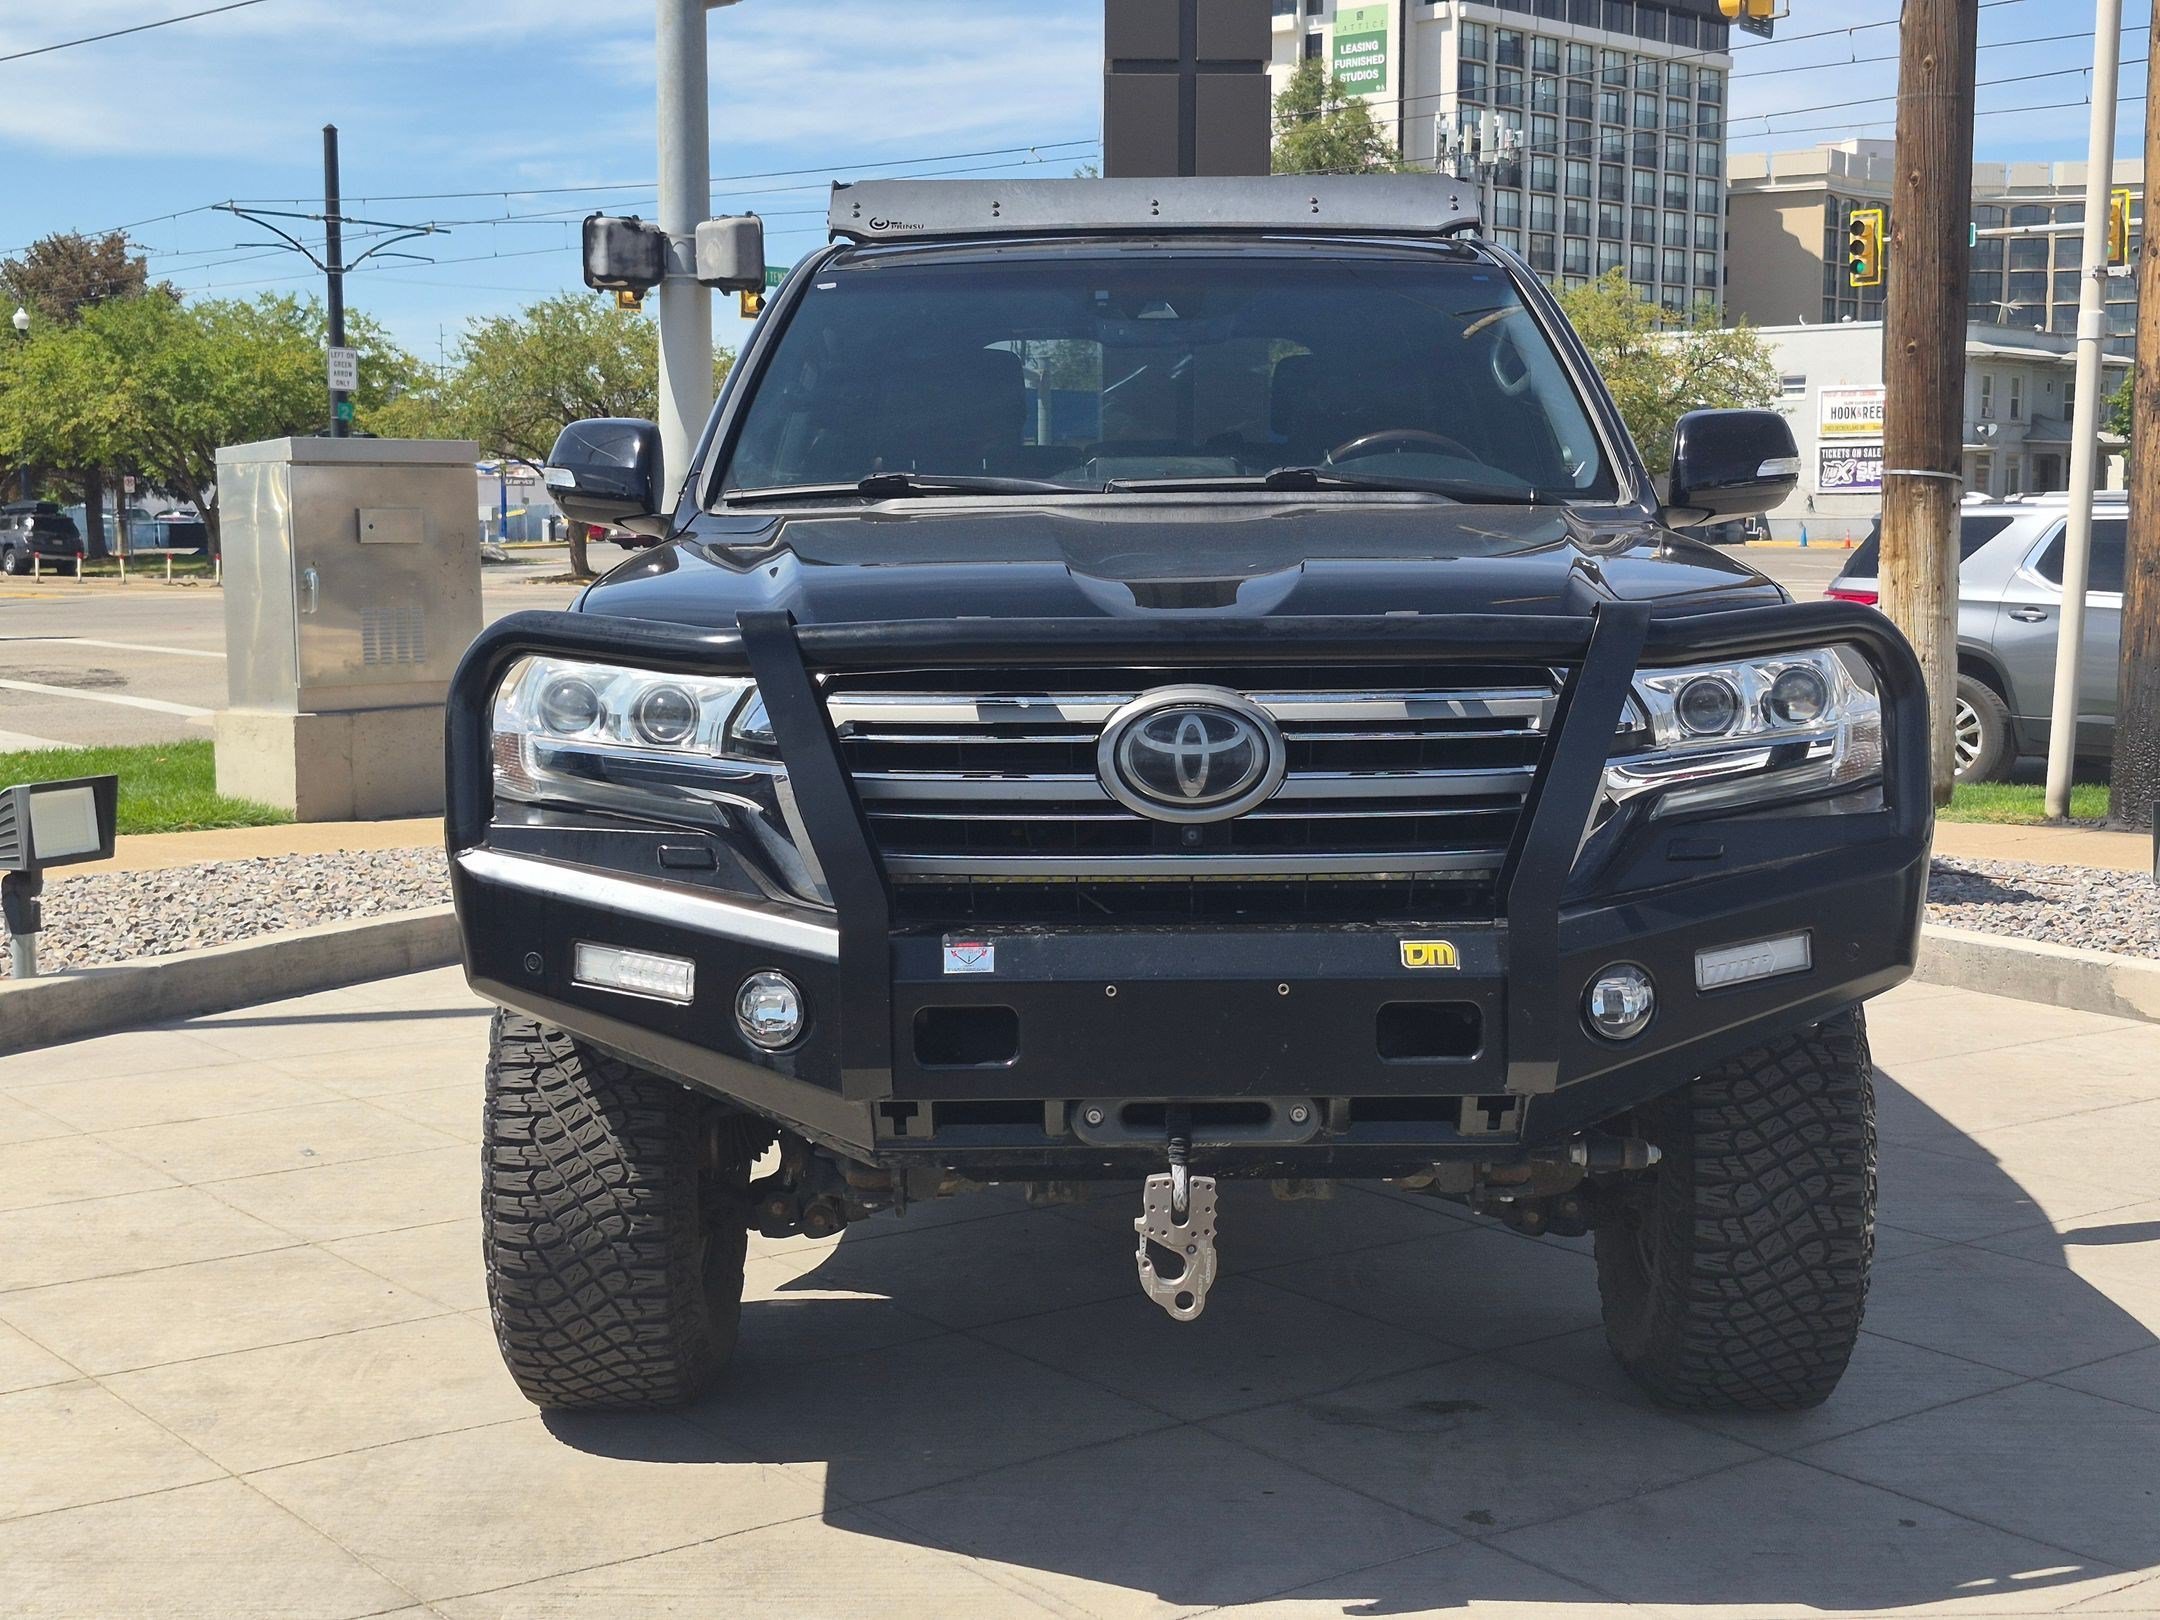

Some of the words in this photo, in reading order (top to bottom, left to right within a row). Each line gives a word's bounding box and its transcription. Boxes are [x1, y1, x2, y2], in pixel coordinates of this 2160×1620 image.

[1335, 20, 1385, 34] LATTICE
[1340, 40, 1379, 54] LEASING
[1334, 54, 1385, 69] FURNISHED
[1339, 69, 1379, 83] STUDIOS
[330, 351, 344, 359] LEFT
[346, 352, 355, 360] ON
[333, 360, 352, 369] GREEN
[333, 370, 353, 378] ARROW
[335, 379, 350, 388] ONLY
[1821, 448, 1850, 459] TICKETS
[1851, 448, 1862, 458] ON
[1863, 447, 1882, 458] SALE
